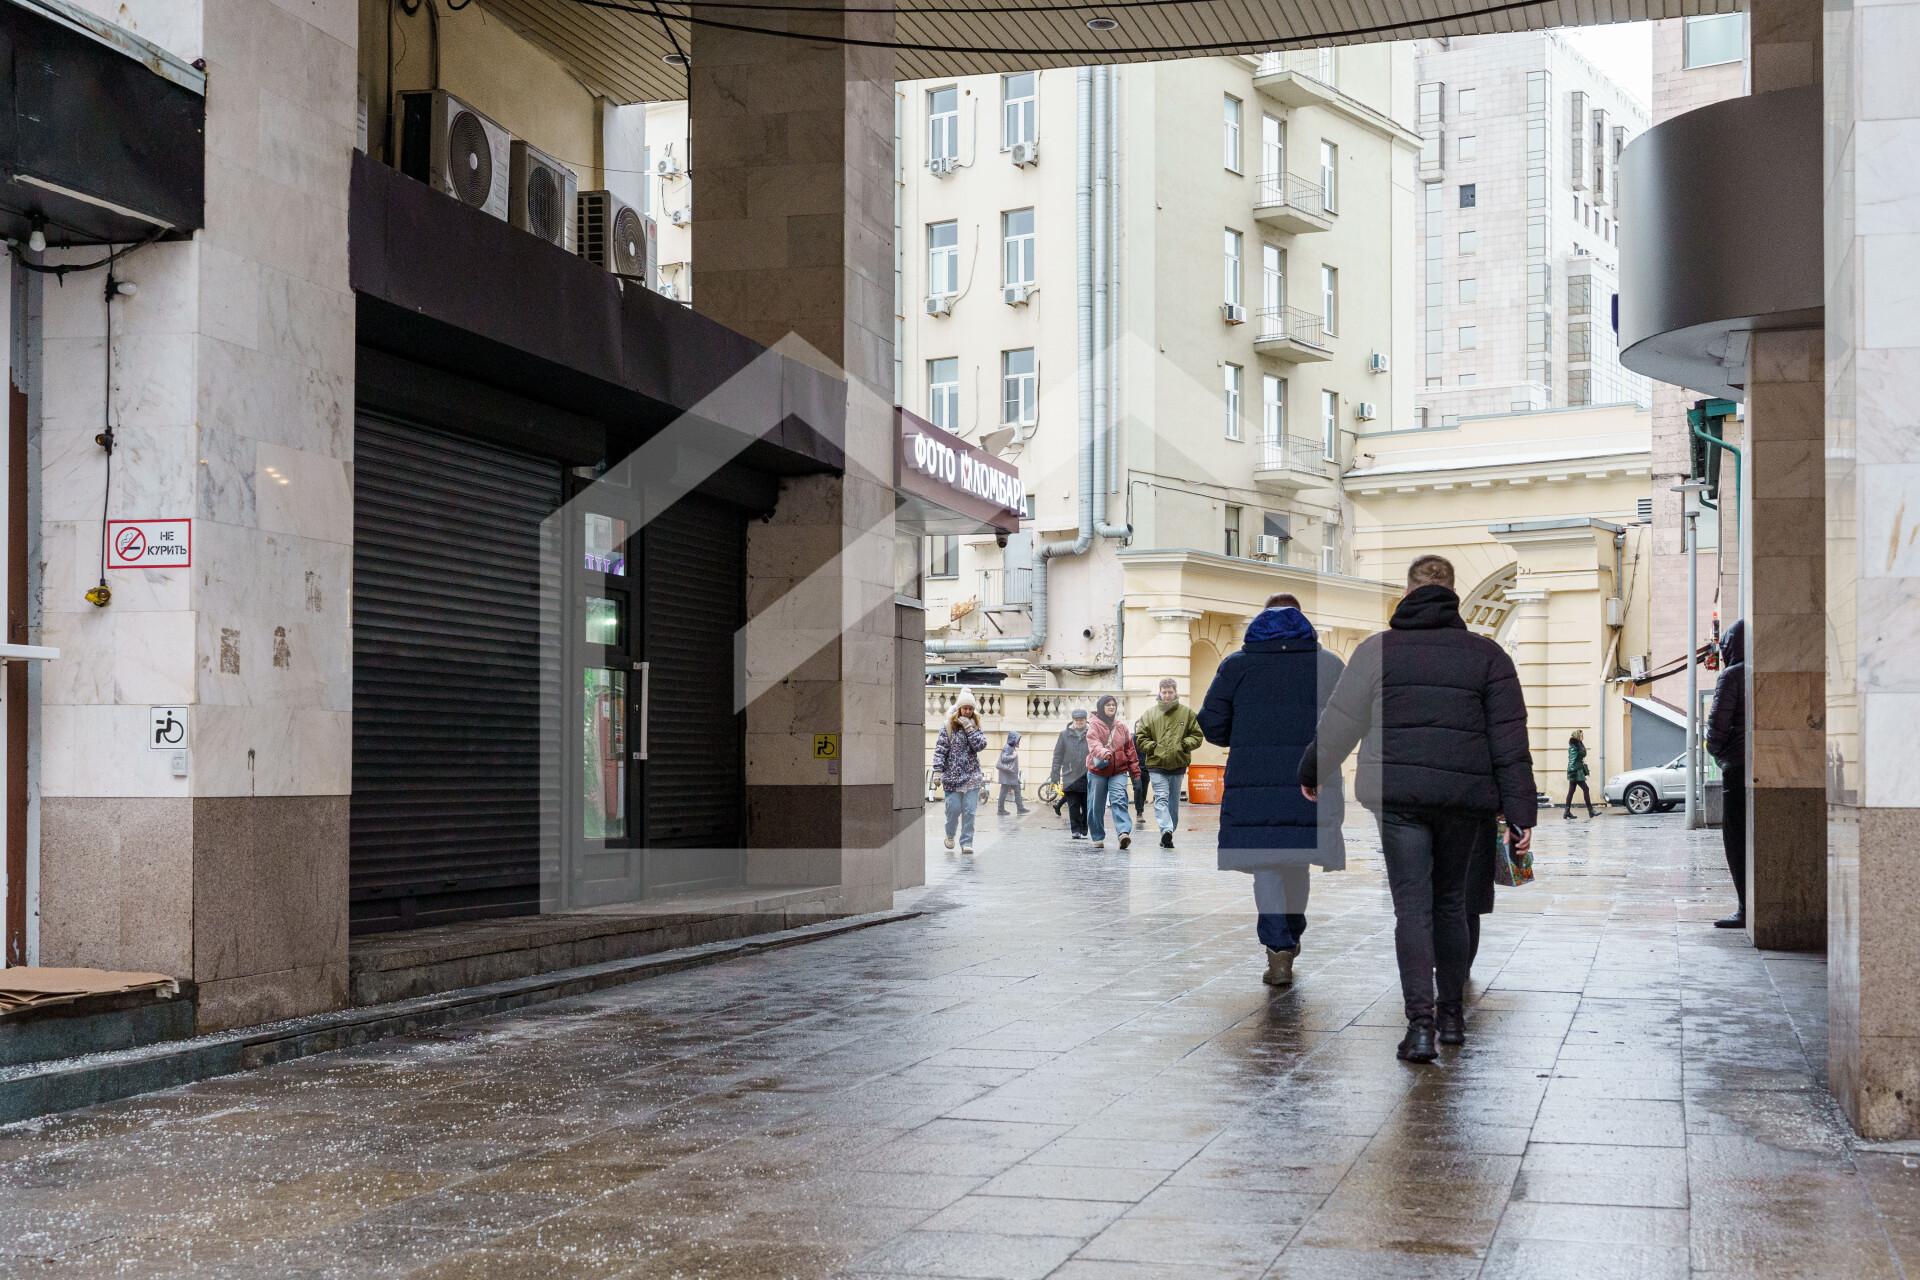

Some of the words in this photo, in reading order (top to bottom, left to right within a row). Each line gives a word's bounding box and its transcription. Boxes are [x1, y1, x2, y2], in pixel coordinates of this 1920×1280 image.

[915, 432, 956, 483] ФОТО
[160, 531, 174, 541] НЕ
[147, 545, 187, 556] КУРИТЬ
